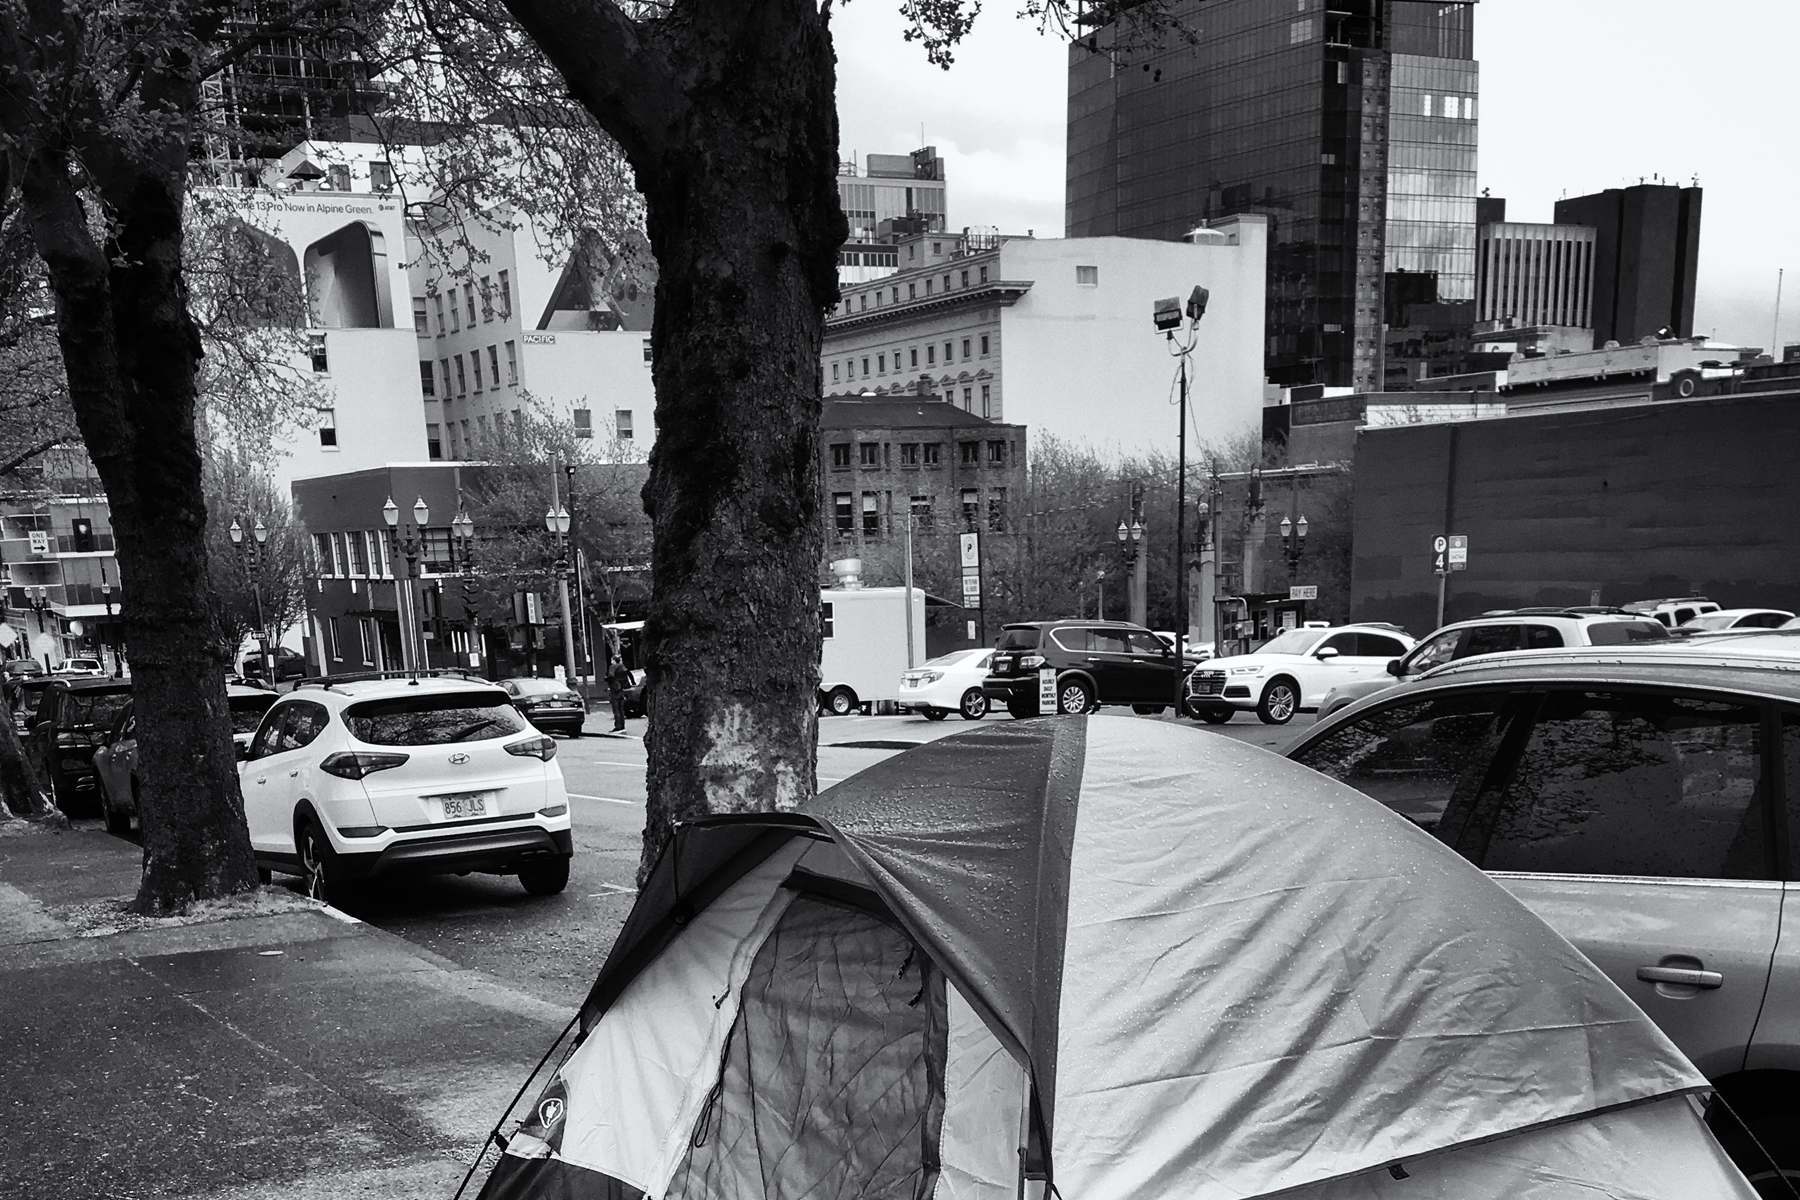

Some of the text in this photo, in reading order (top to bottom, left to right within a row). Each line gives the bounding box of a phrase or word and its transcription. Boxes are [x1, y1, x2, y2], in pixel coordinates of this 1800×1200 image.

[256, 201, 266, 211] 13
[267, 202, 283, 211] Pro
[284, 202, 305, 212] Now
[307, 203, 315, 212] in
[316, 203, 344, 214] Alpine
[345, 204, 374, 214] Green.
[523, 335, 555, 344] PACIFIC
[1435, 553, 1444, 568] 4
[1291, 587, 1316, 598] PAY HERE
[445, 801, 462, 814] 856
